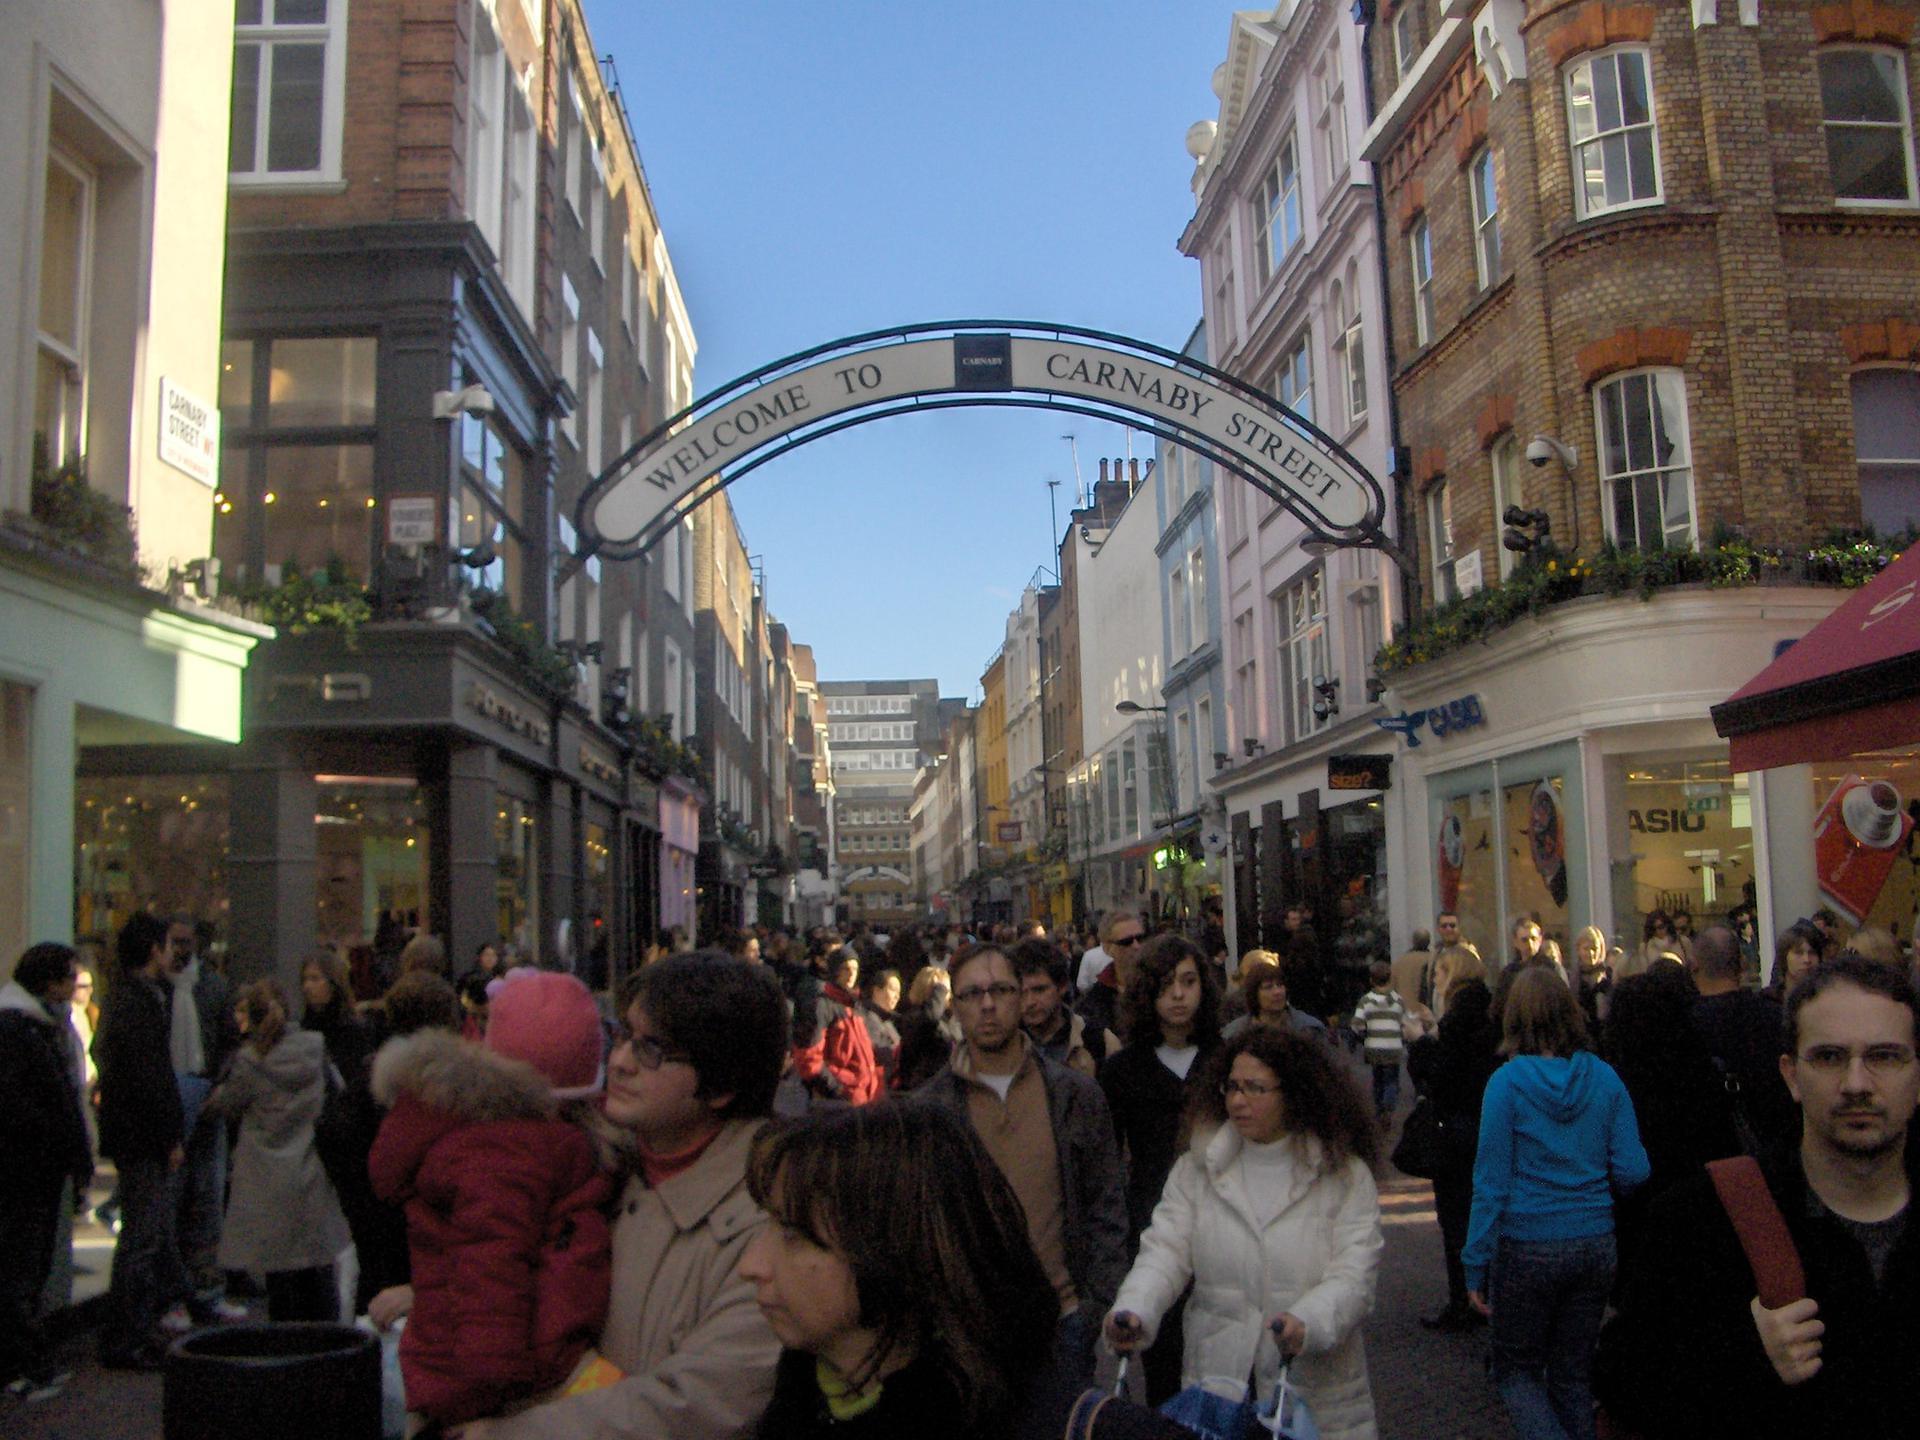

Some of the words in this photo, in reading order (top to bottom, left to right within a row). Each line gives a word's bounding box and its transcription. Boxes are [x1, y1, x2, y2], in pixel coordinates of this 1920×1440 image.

[962, 357, 1002, 366] CARNABY
[169, 389, 207, 430] CARNABY
[645, 385, 811, 493] WELCOME
[835, 363, 882, 395] TO
[1046, 353, 1214, 418] CARNABY
[1225, 412, 1341, 500] STREET
[169, 414, 199, 448] STREET
[1331, 770, 1373, 788] size?
